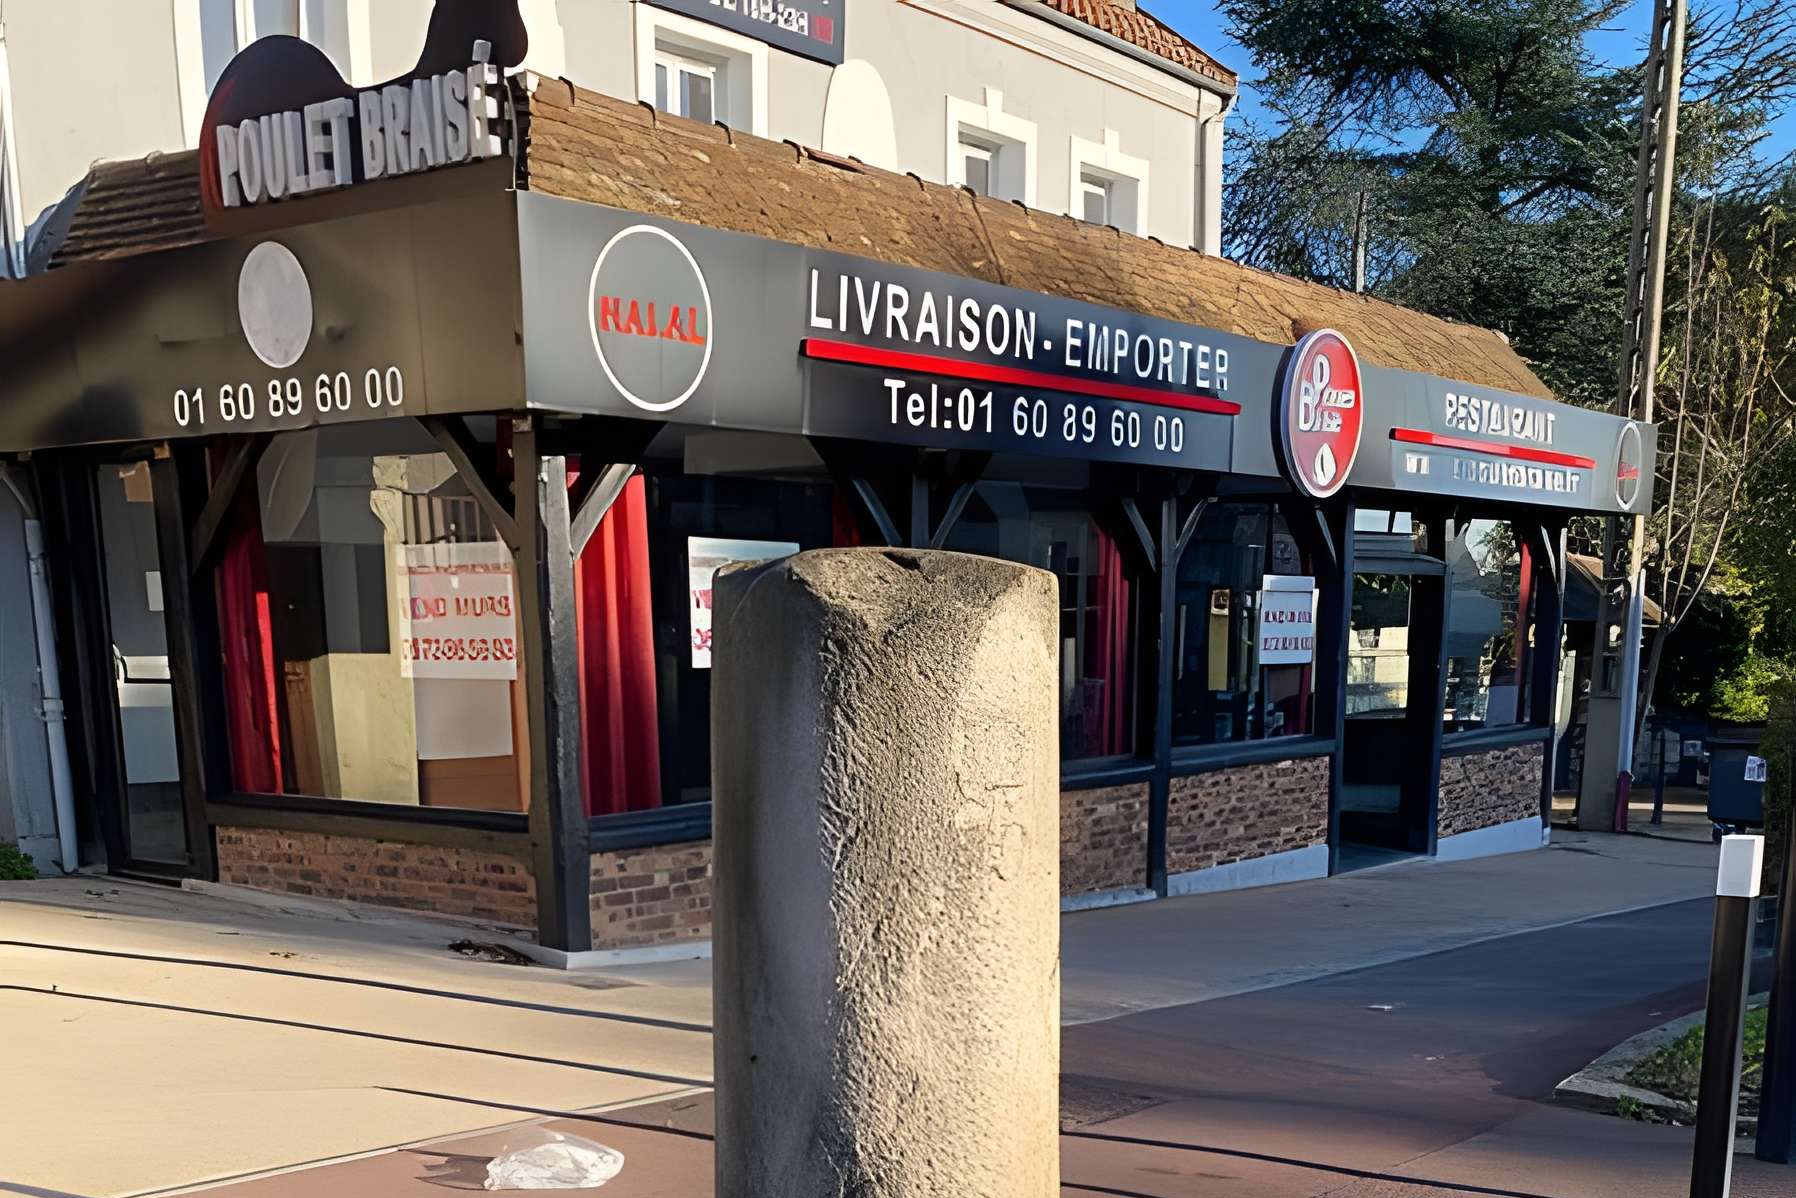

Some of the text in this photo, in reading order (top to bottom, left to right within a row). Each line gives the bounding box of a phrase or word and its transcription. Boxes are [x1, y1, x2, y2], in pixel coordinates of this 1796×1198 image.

[216, 39, 501, 207] POULET BRAISÉ
[599, 295, 705, 345] HALAL
[810, 268, 1229, 391] LIVRAISON EMPORTER
[174, 366, 403, 426] 01 60 89 60 00
[1013, 396, 1048, 438] 60
[1063, 403, 1096, 443] 89
[1111, 409, 1141, 448] 60
[1154, 416, 1184, 453] 00
